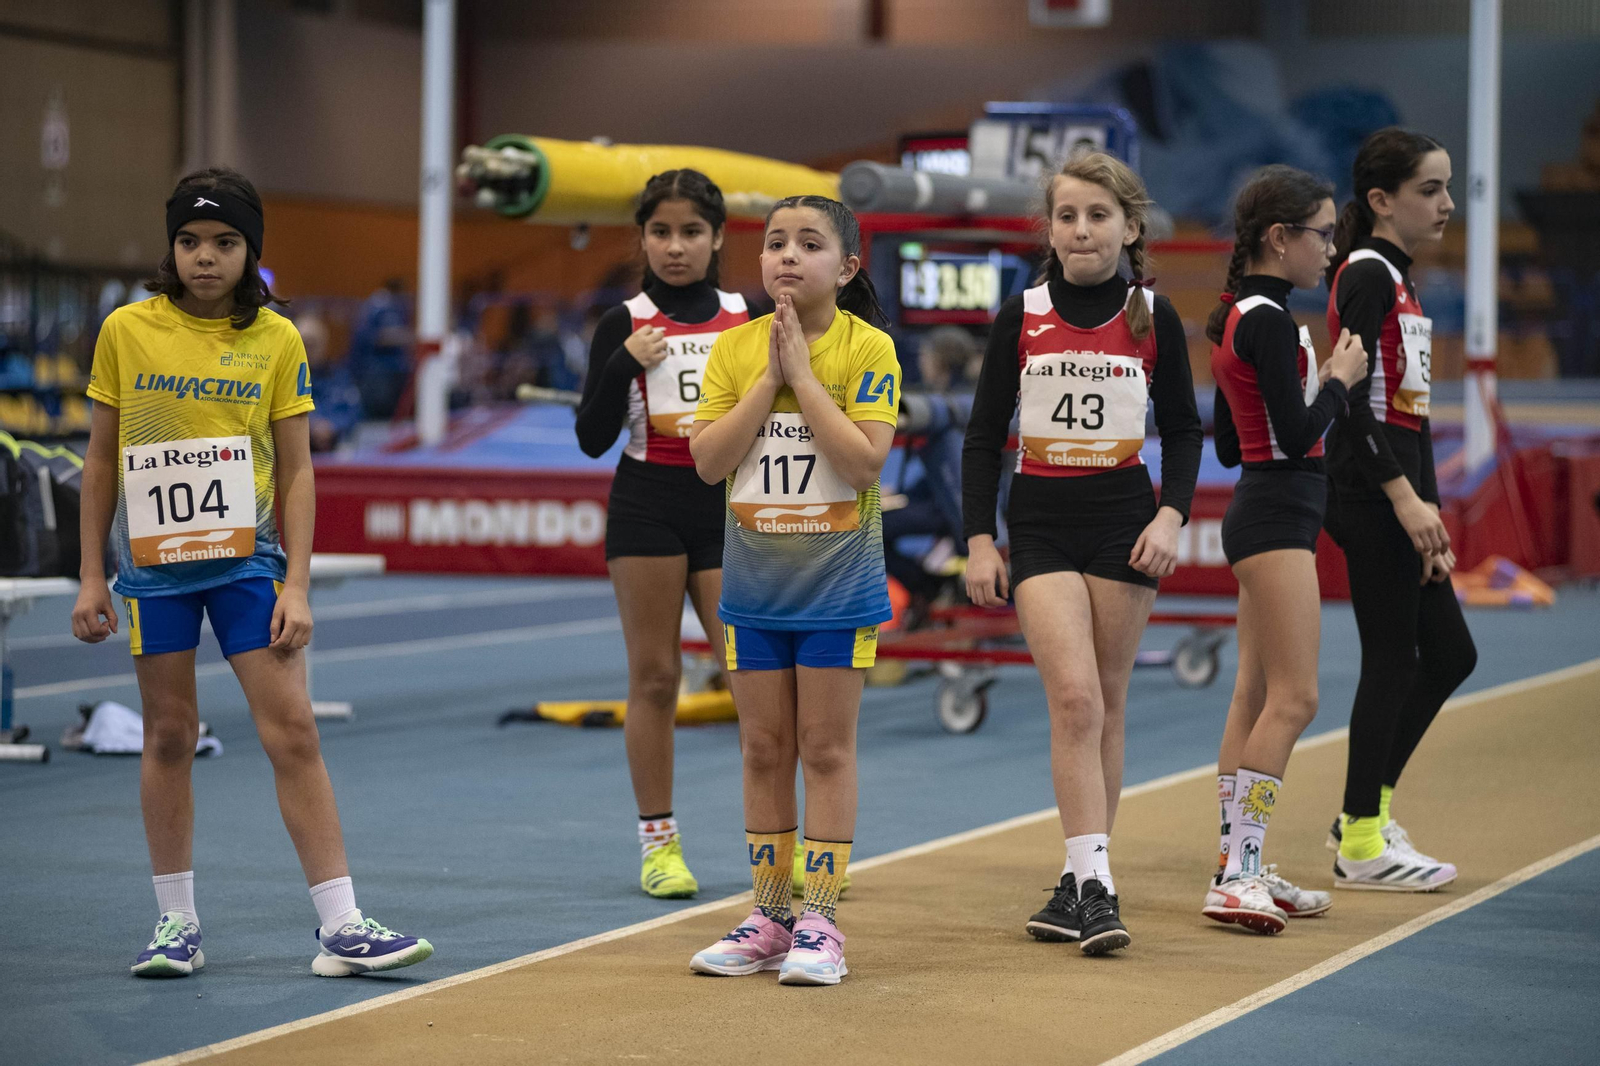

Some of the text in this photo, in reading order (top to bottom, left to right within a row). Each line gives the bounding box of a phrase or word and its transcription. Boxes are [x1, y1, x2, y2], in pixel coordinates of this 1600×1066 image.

[233, 360, 269, 370] DENTAL
[234, 352, 271, 362] ARRANZ
[1026, 361, 1054, 376] La
[134, 373, 262, 400] LIMIACTIVA
[297, 362, 311, 396] L
[855, 371, 894, 407] LA
[1051, 393, 1105, 430] 43
[756, 425, 766, 438] a
[127, 454, 158, 472] La
[1046, 452, 1118, 467] telemiño
[759, 454, 817, 495] 117
[148, 479, 230, 525] 104
[409, 500, 603, 545] MONDO
[755, 519, 832, 533] telemiño
[159, 544, 237, 565] telemiño
[806, 850, 834, 875] LA
